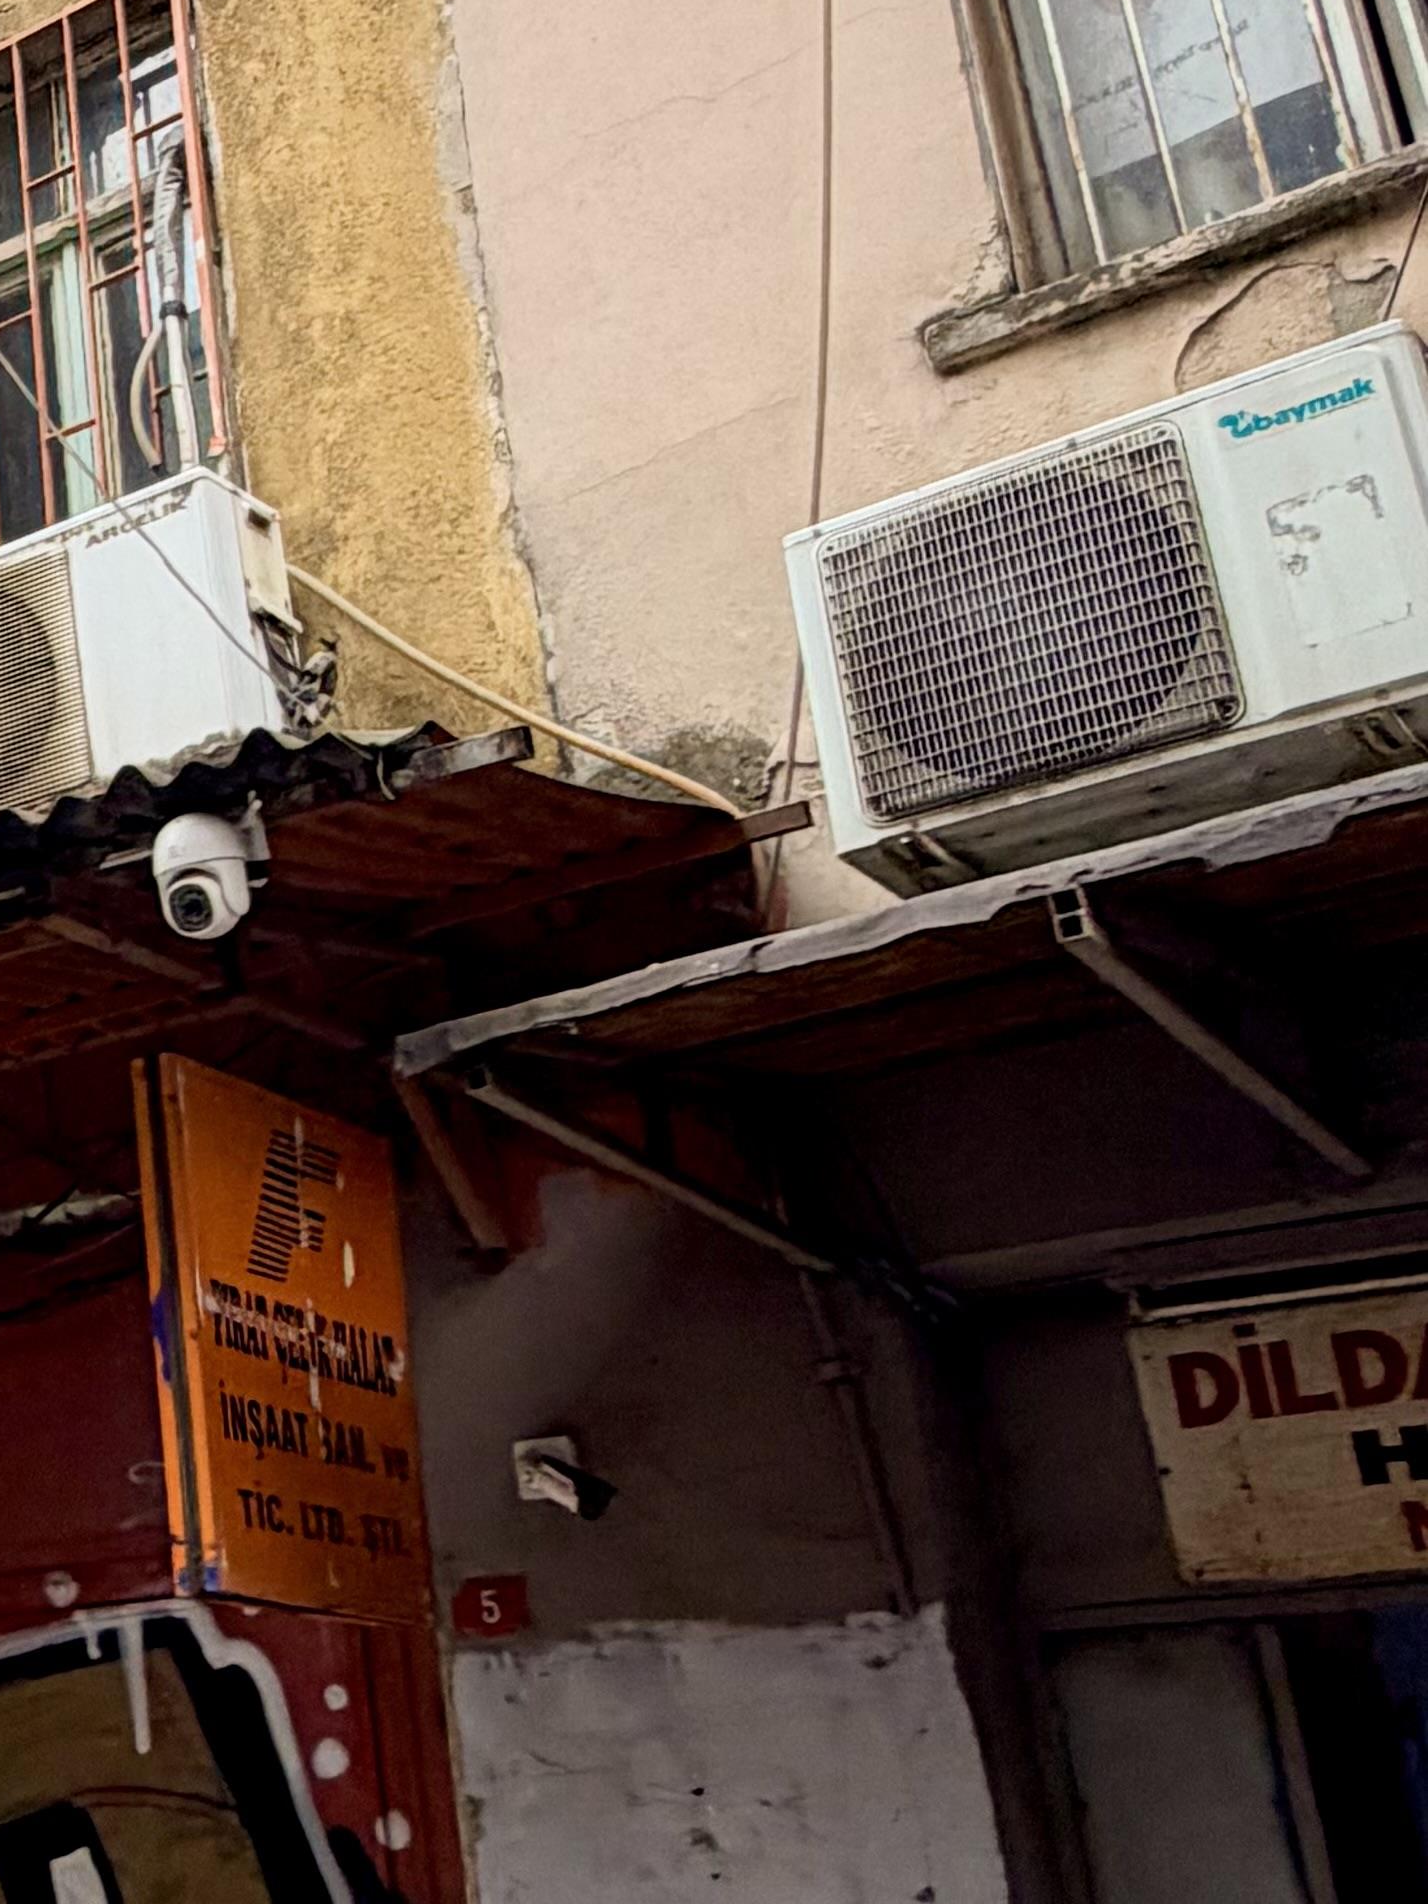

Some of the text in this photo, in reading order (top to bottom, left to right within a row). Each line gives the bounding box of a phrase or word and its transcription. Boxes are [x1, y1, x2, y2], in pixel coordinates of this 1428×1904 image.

[1252, 377, 1376, 431] baymak
[1168, 1323, 1428, 1429] DİLD
[219, 1379, 308, 1460] İNŞAAT
[480, 1590, 502, 1624] 5
